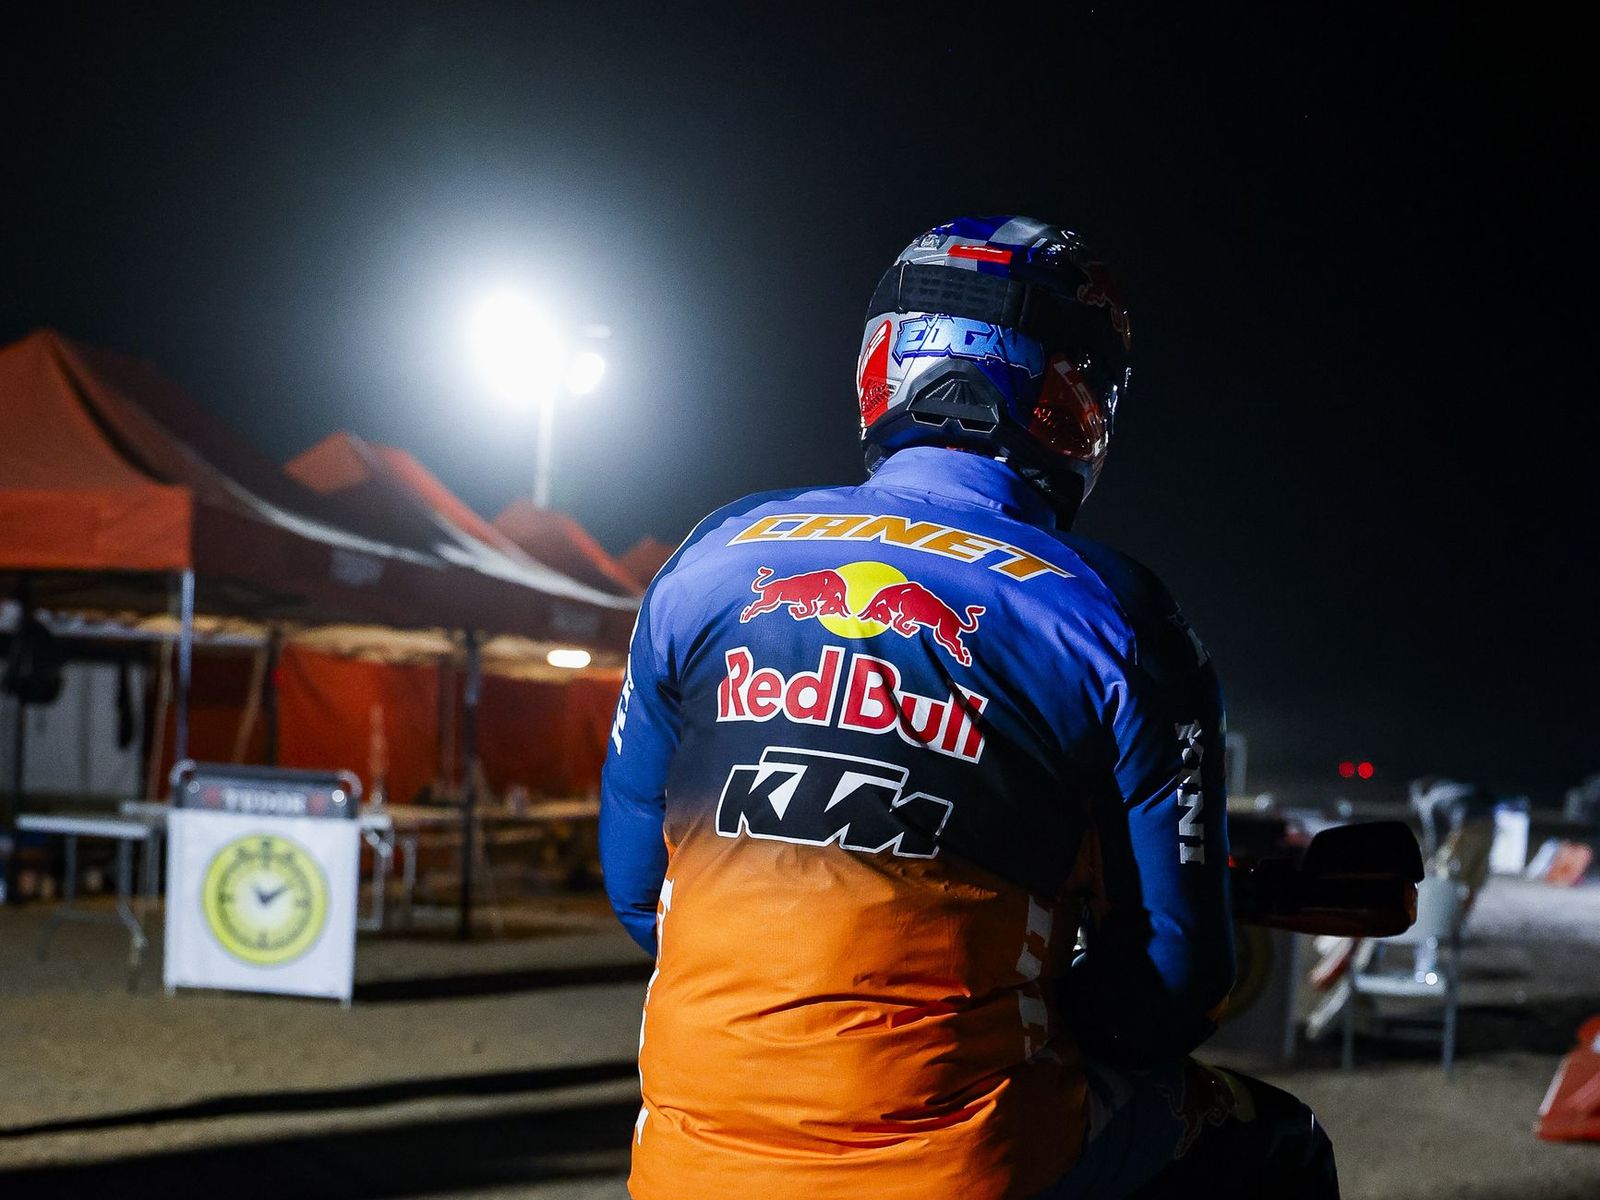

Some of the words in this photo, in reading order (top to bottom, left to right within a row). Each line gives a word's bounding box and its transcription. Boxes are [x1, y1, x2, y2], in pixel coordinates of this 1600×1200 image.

[725, 514, 1077, 582] CANET
[716, 645, 846, 727] Red
[837, 653, 989, 764] Bull
[715, 745, 954, 859] KTM
